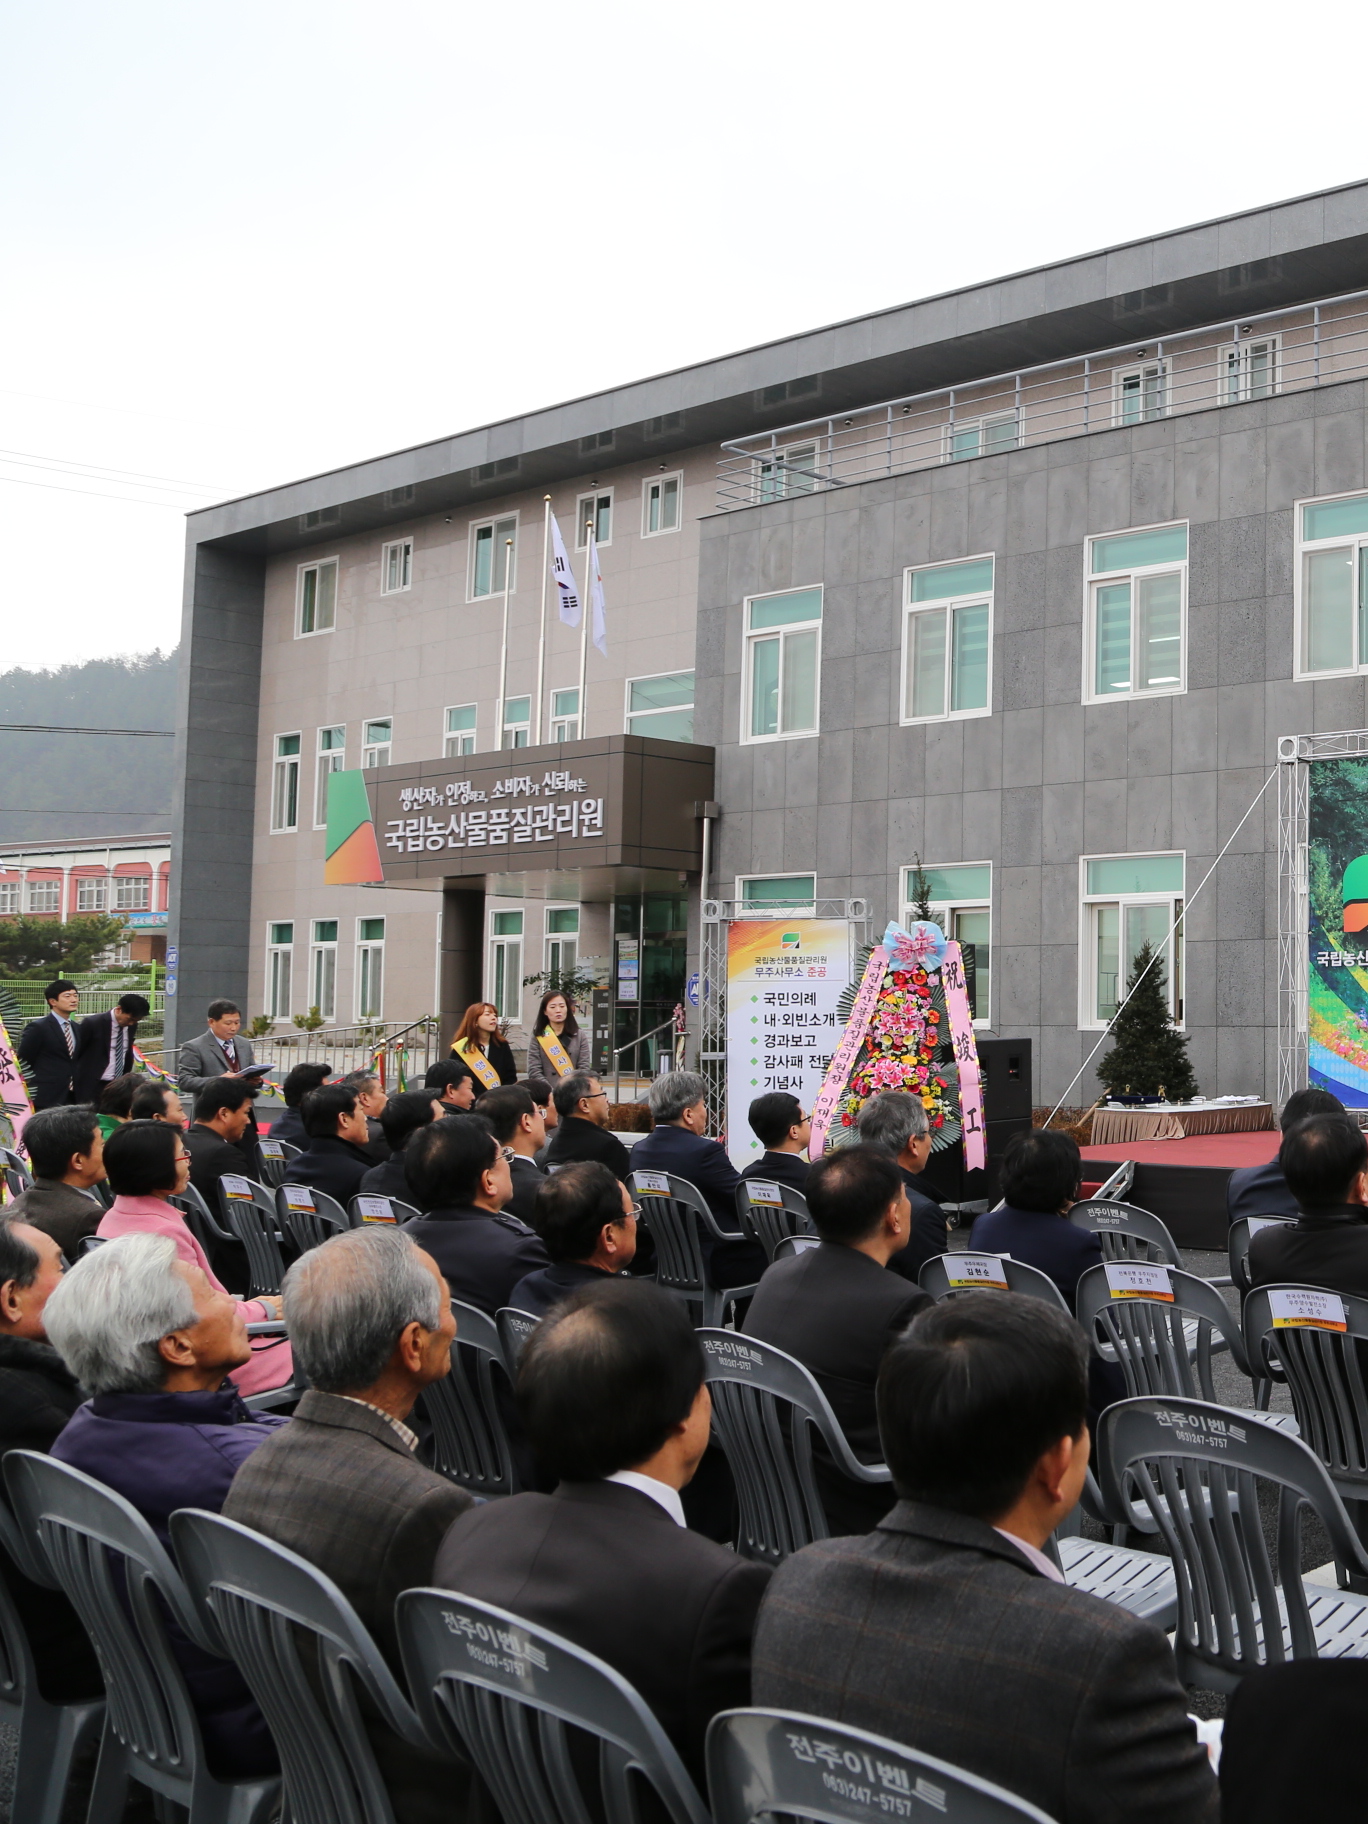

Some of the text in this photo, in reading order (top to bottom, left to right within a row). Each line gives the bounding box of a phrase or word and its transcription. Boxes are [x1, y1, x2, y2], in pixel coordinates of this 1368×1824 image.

[399, 787, 445, 811] 생산자가
[491, 776, 540, 799] 소비자가
[542, 771, 588, 796] 신뢰하는
[384, 798, 604, 853] 국립농산물품질관리원
[754, 956, 828, 965] 국립농산물품질관리원
[755, 966, 827, 978] 무주사무소 준공
[763, 992, 816, 1007] 국민의례
[763, 1034, 817, 1048] 경과보고
[764, 1055, 803, 1069] 감사패
[764, 1075, 804, 1090] 기념사
[1087, 1208, 1128, 1220] 전주이벤트
[704, 1339, 763, 1365] 전주이벤트
[1154, 1411, 1247, 1443] 전주이벤트
[1176, 1430, 1228, 1448] 063)247-5757
[441, 1610, 549, 1672] 전주이벤트
[786, 1733, 947, 1812] 전주이벤트
[822, 1772, 912, 1816] 063)247-5757
